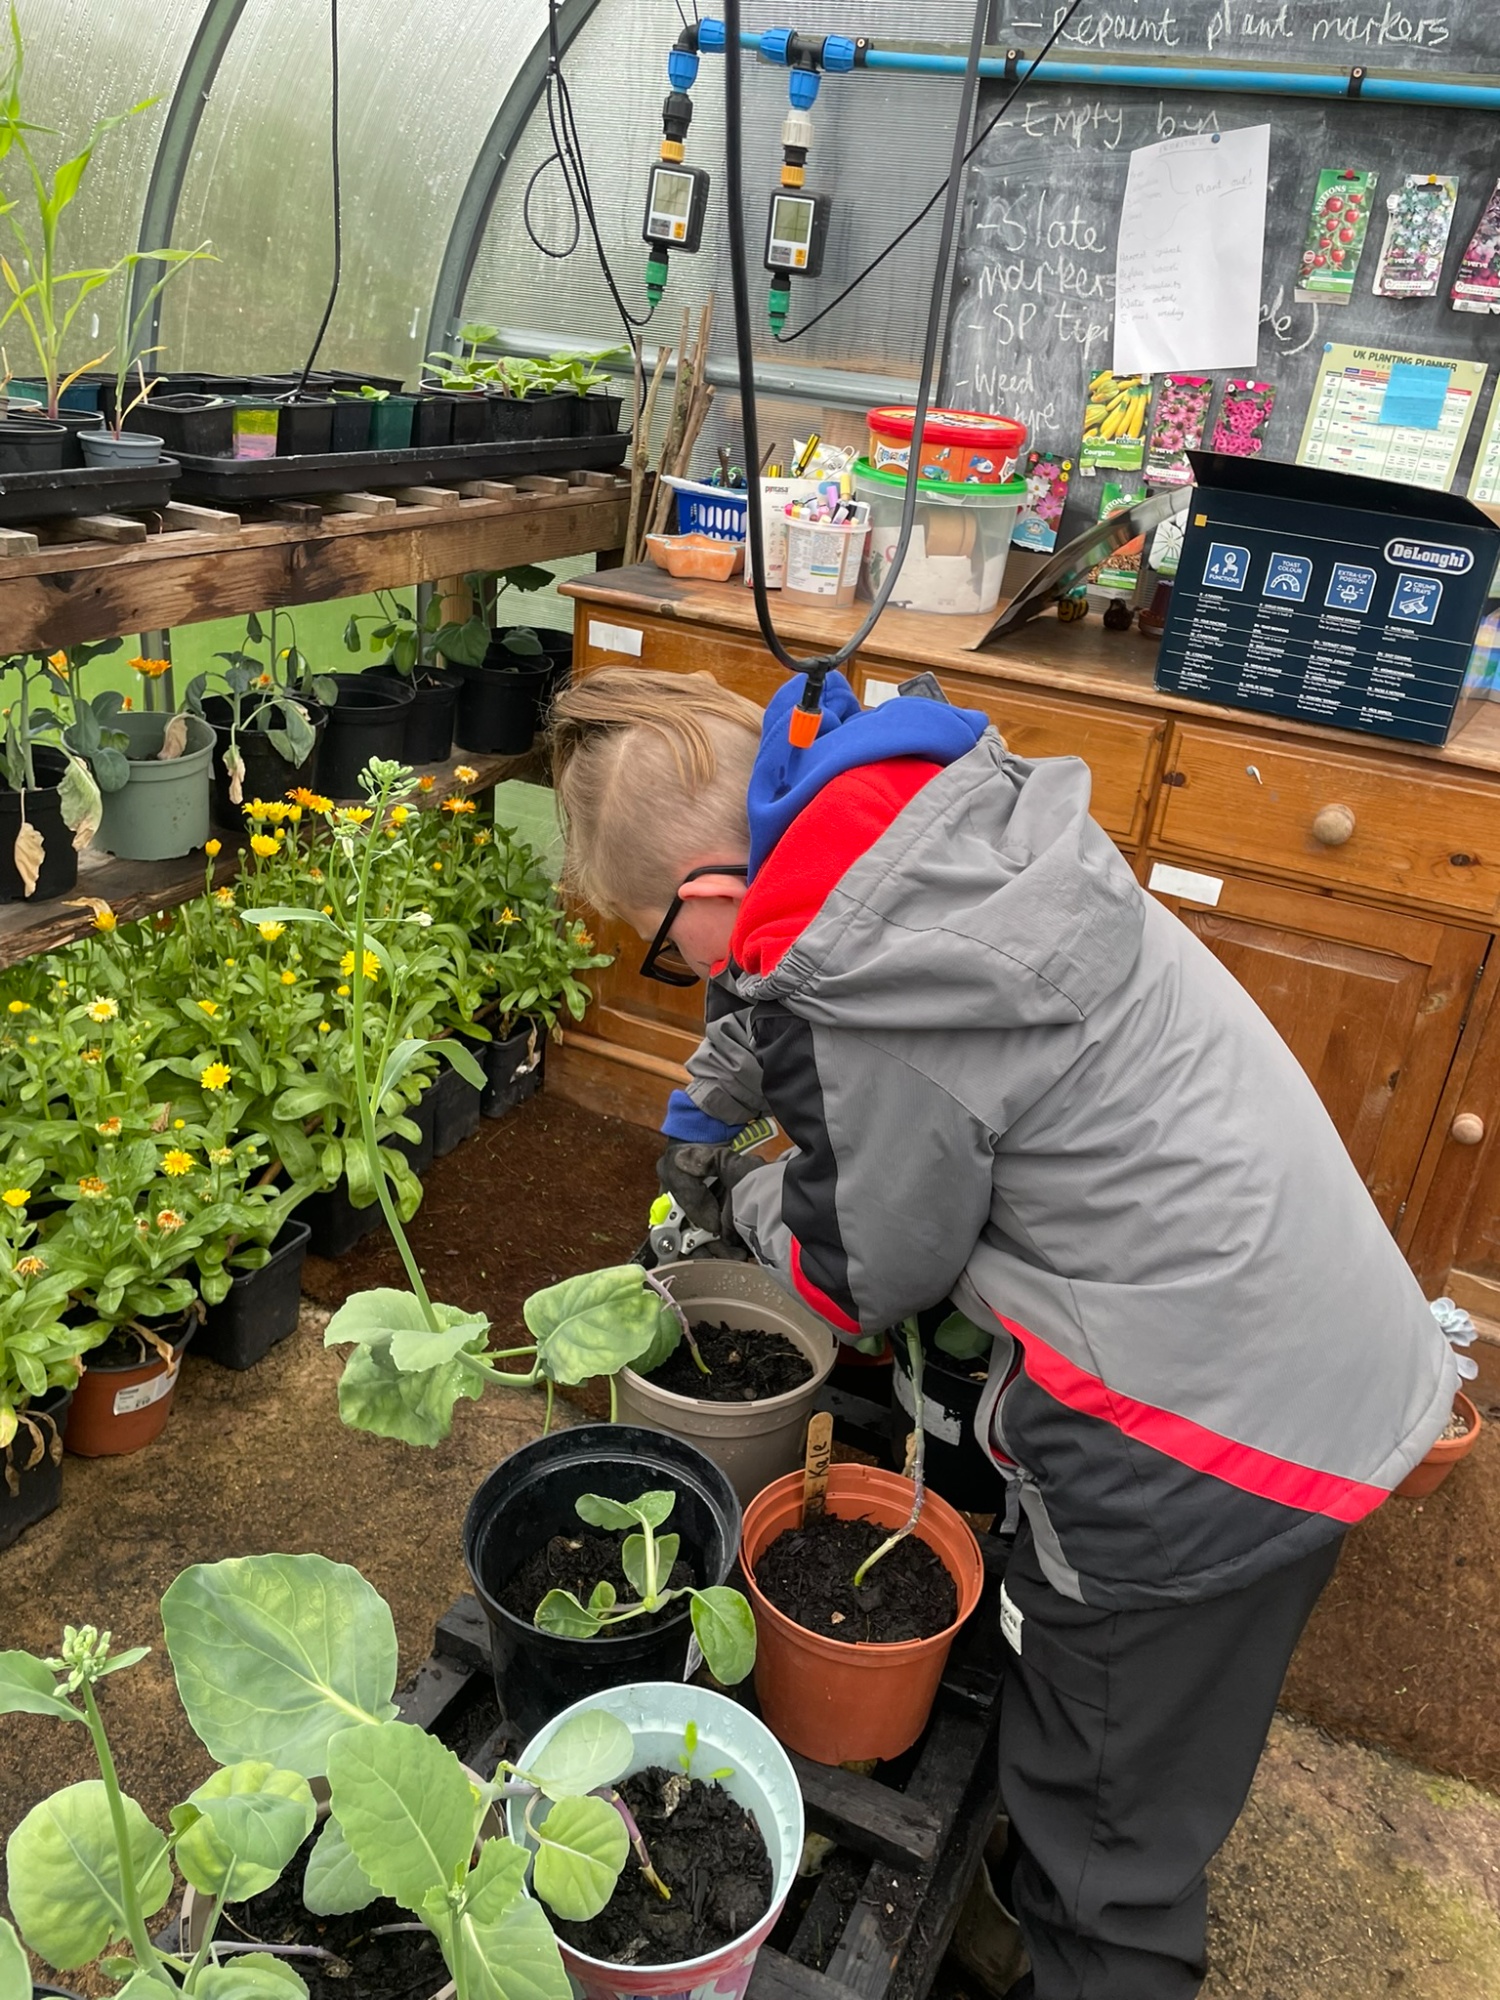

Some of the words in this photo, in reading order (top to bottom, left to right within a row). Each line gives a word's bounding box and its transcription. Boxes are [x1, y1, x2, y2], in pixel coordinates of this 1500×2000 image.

[1207, 0, 1293, 51] plant
[1312, 2, 1449, 46] markers
[1315, 184, 1347, 211] SUTTONS
[1353, 350, 1367, 359] UK
[1368, 352, 1413, 365] PLANTING
[1083, 449, 1116, 458] Courgette
[1210, 563, 1220, 575] 4
[1282, 560, 1301, 568] TOAST
[1277, 566, 1303, 574] COLOUR
[1337, 570, 1372, 579] EXTRA-LIFT
[1209, 574, 1240, 584] FUNCTIONS
[1338, 577, 1368, 585] POSITION
[1403, 581, 1412, 593] 2
[1413, 582, 1436, 591] CRUMB
[1412, 587, 1432, 596] TRAYS
[808, 1441, 830, 1480] Kale
